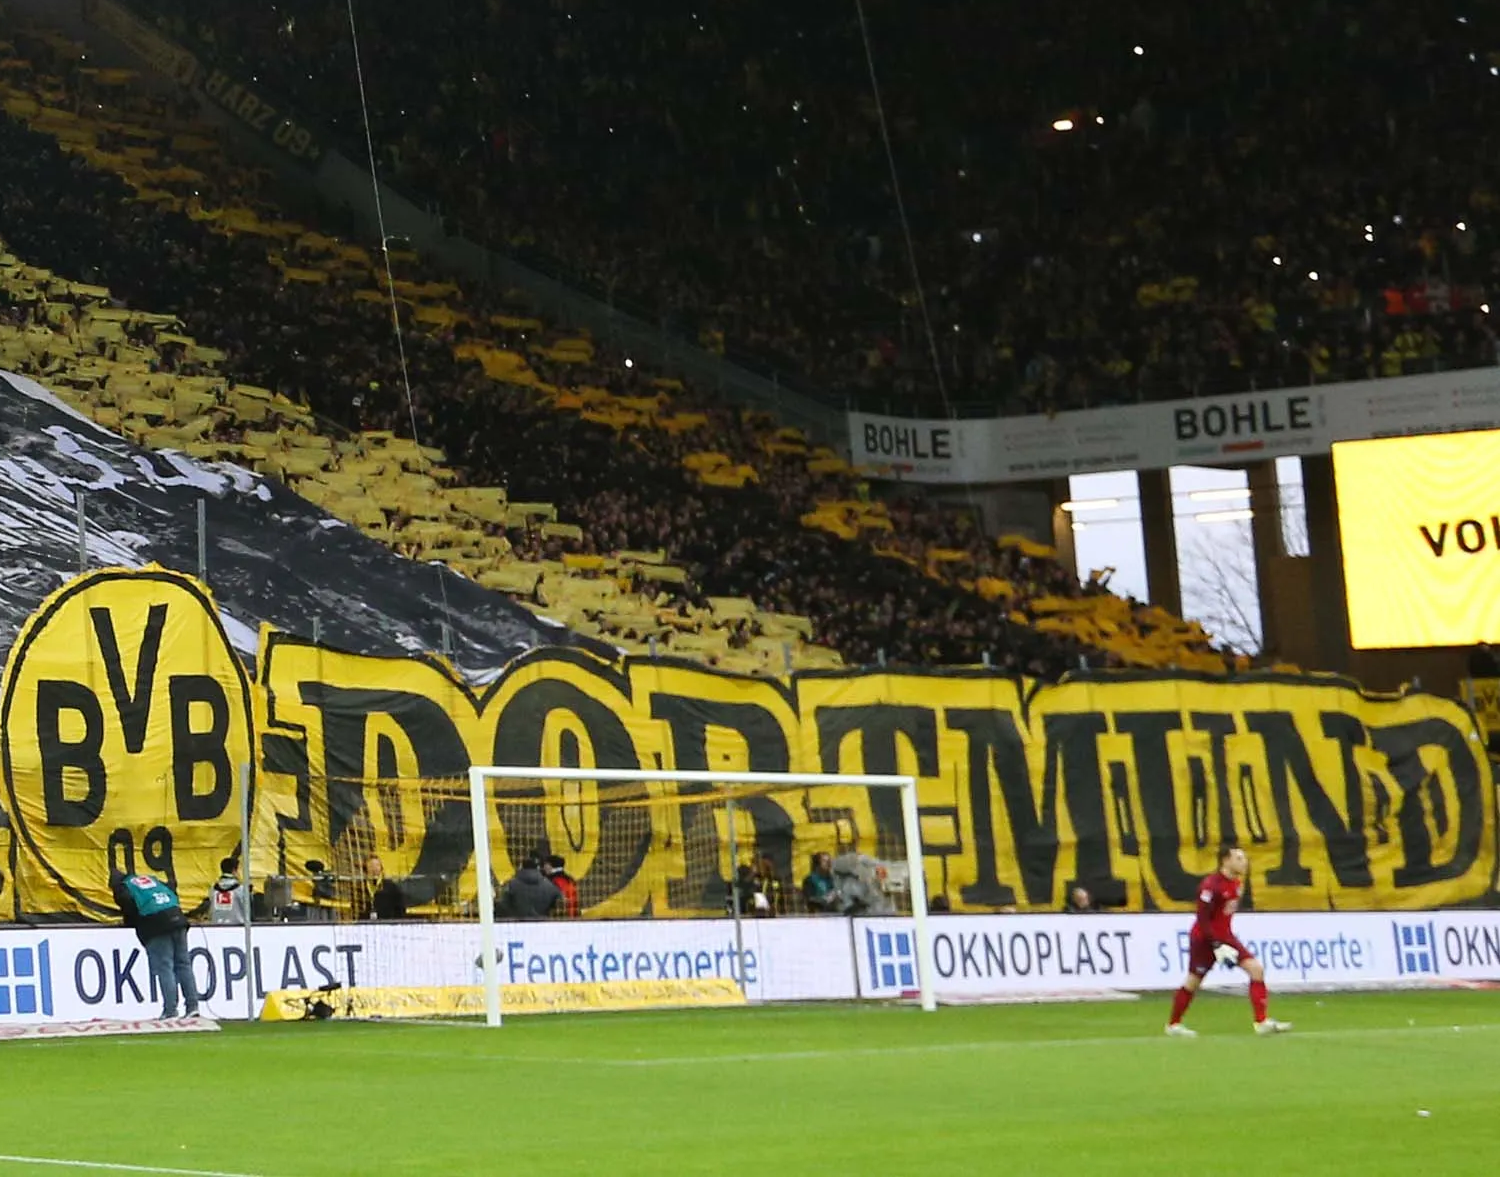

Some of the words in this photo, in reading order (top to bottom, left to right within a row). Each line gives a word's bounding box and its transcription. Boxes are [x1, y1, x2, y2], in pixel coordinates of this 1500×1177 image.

[864, 423, 953, 460] BOHLE
[1174, 396, 1312, 441] BOHLE
[37, 603, 233, 826] BVB
[298, 678, 1485, 913] DORTMUND
[107, 826, 178, 887] 09
[933, 931, 1132, 979] OKNOPLAST
[1444, 925, 1500, 966] OKN
